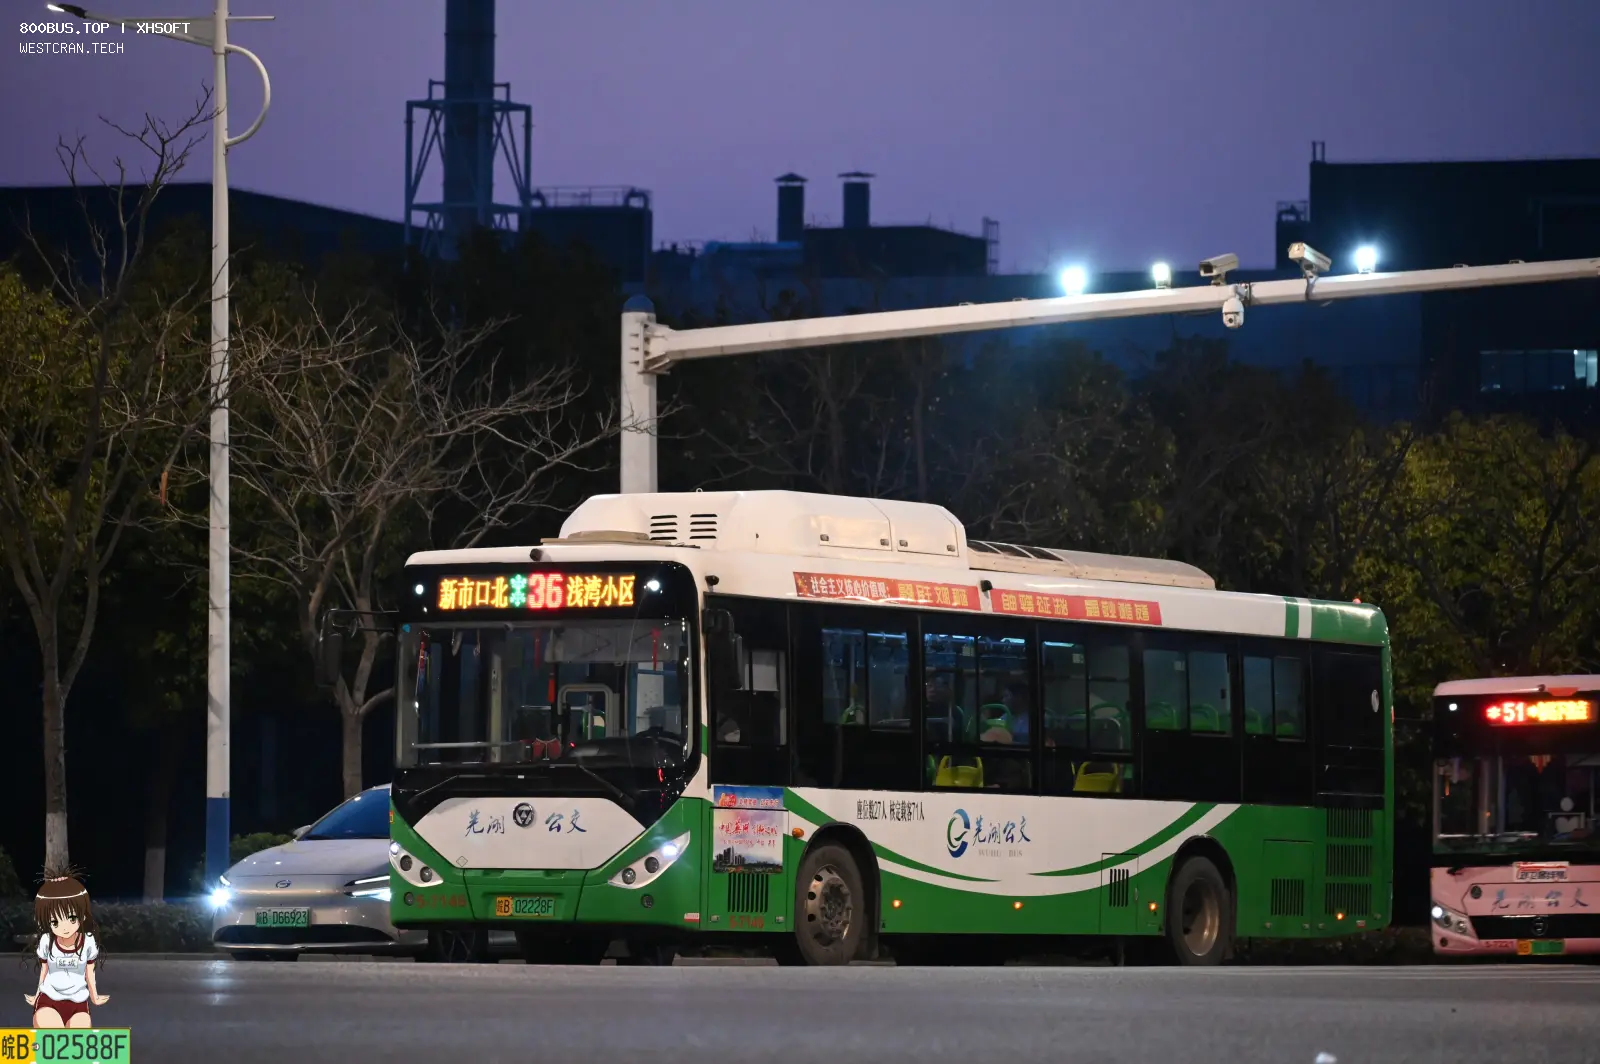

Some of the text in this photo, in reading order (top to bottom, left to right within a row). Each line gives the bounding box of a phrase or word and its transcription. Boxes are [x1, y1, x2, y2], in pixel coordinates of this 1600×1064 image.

[439, 577, 508, 609] 新市口北
[528, 573, 564, 609] 36
[1503, 702, 1524, 723] 51
[856, 800, 924, 822] 座位数27人 核定载客71人
[972, 815, 1031, 847] 芜湖公交
[515, 899, 553, 914] 02228F
[273, 911, 307, 925] D66923
